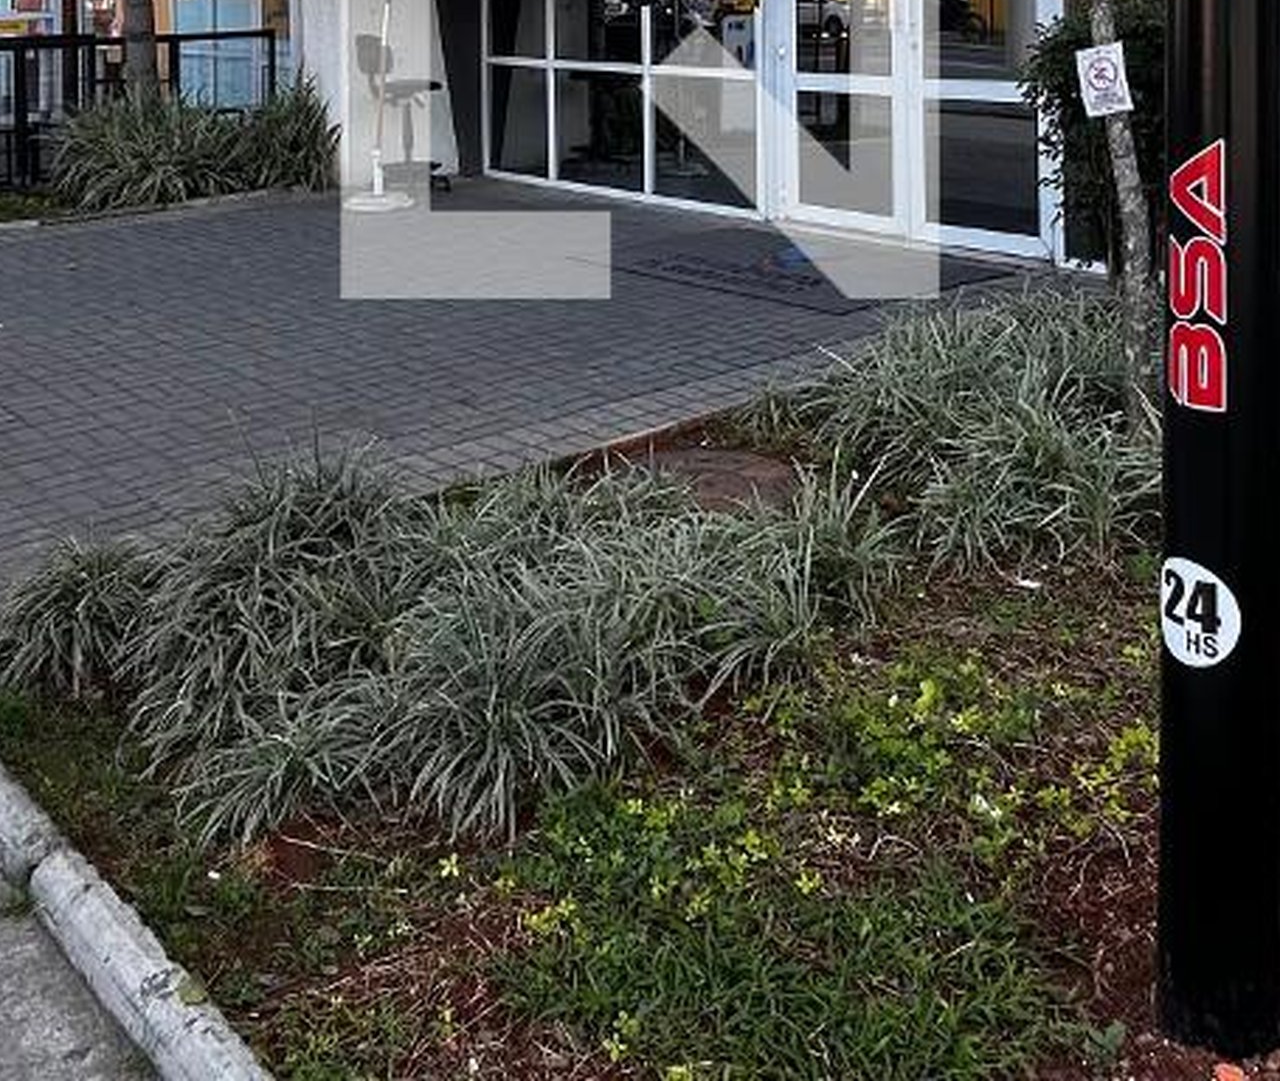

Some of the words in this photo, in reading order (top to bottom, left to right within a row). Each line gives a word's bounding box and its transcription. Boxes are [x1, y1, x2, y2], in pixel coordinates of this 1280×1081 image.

[1169, 138, 1227, 412] BSA
[1164, 568, 1222, 635] 24
[1186, 629, 1220, 659] HS
